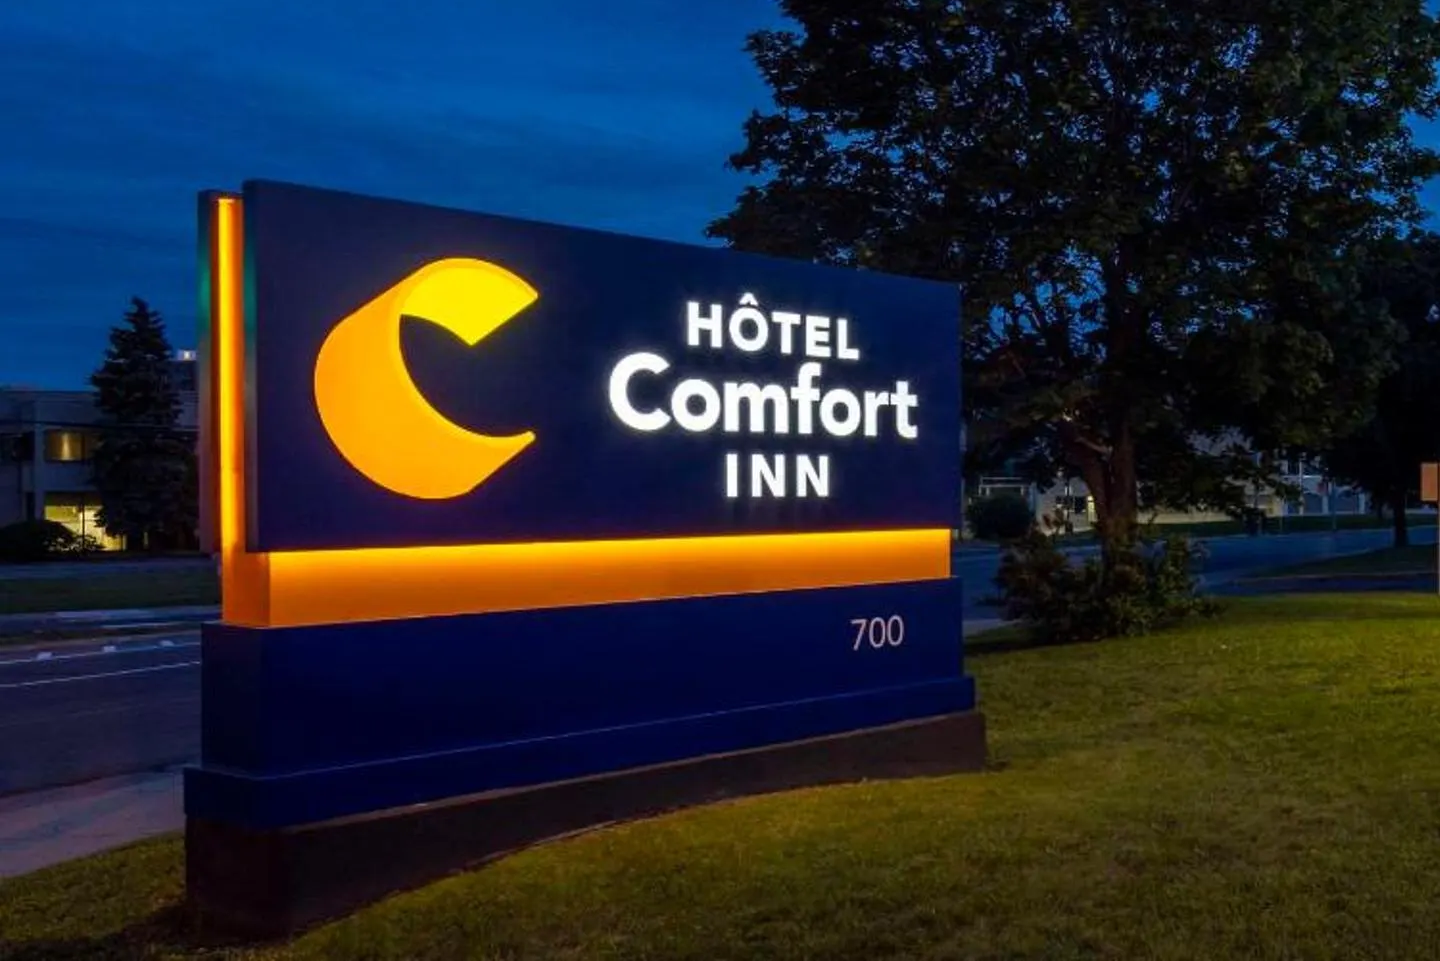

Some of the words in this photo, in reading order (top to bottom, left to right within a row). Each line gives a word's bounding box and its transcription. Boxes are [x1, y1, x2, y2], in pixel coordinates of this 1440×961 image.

[686, 292, 859, 360] HÔTEL
[608, 352, 919, 439] Comfort
[726, 453, 830, 498] INN
[850, 615, 905, 651] 700
